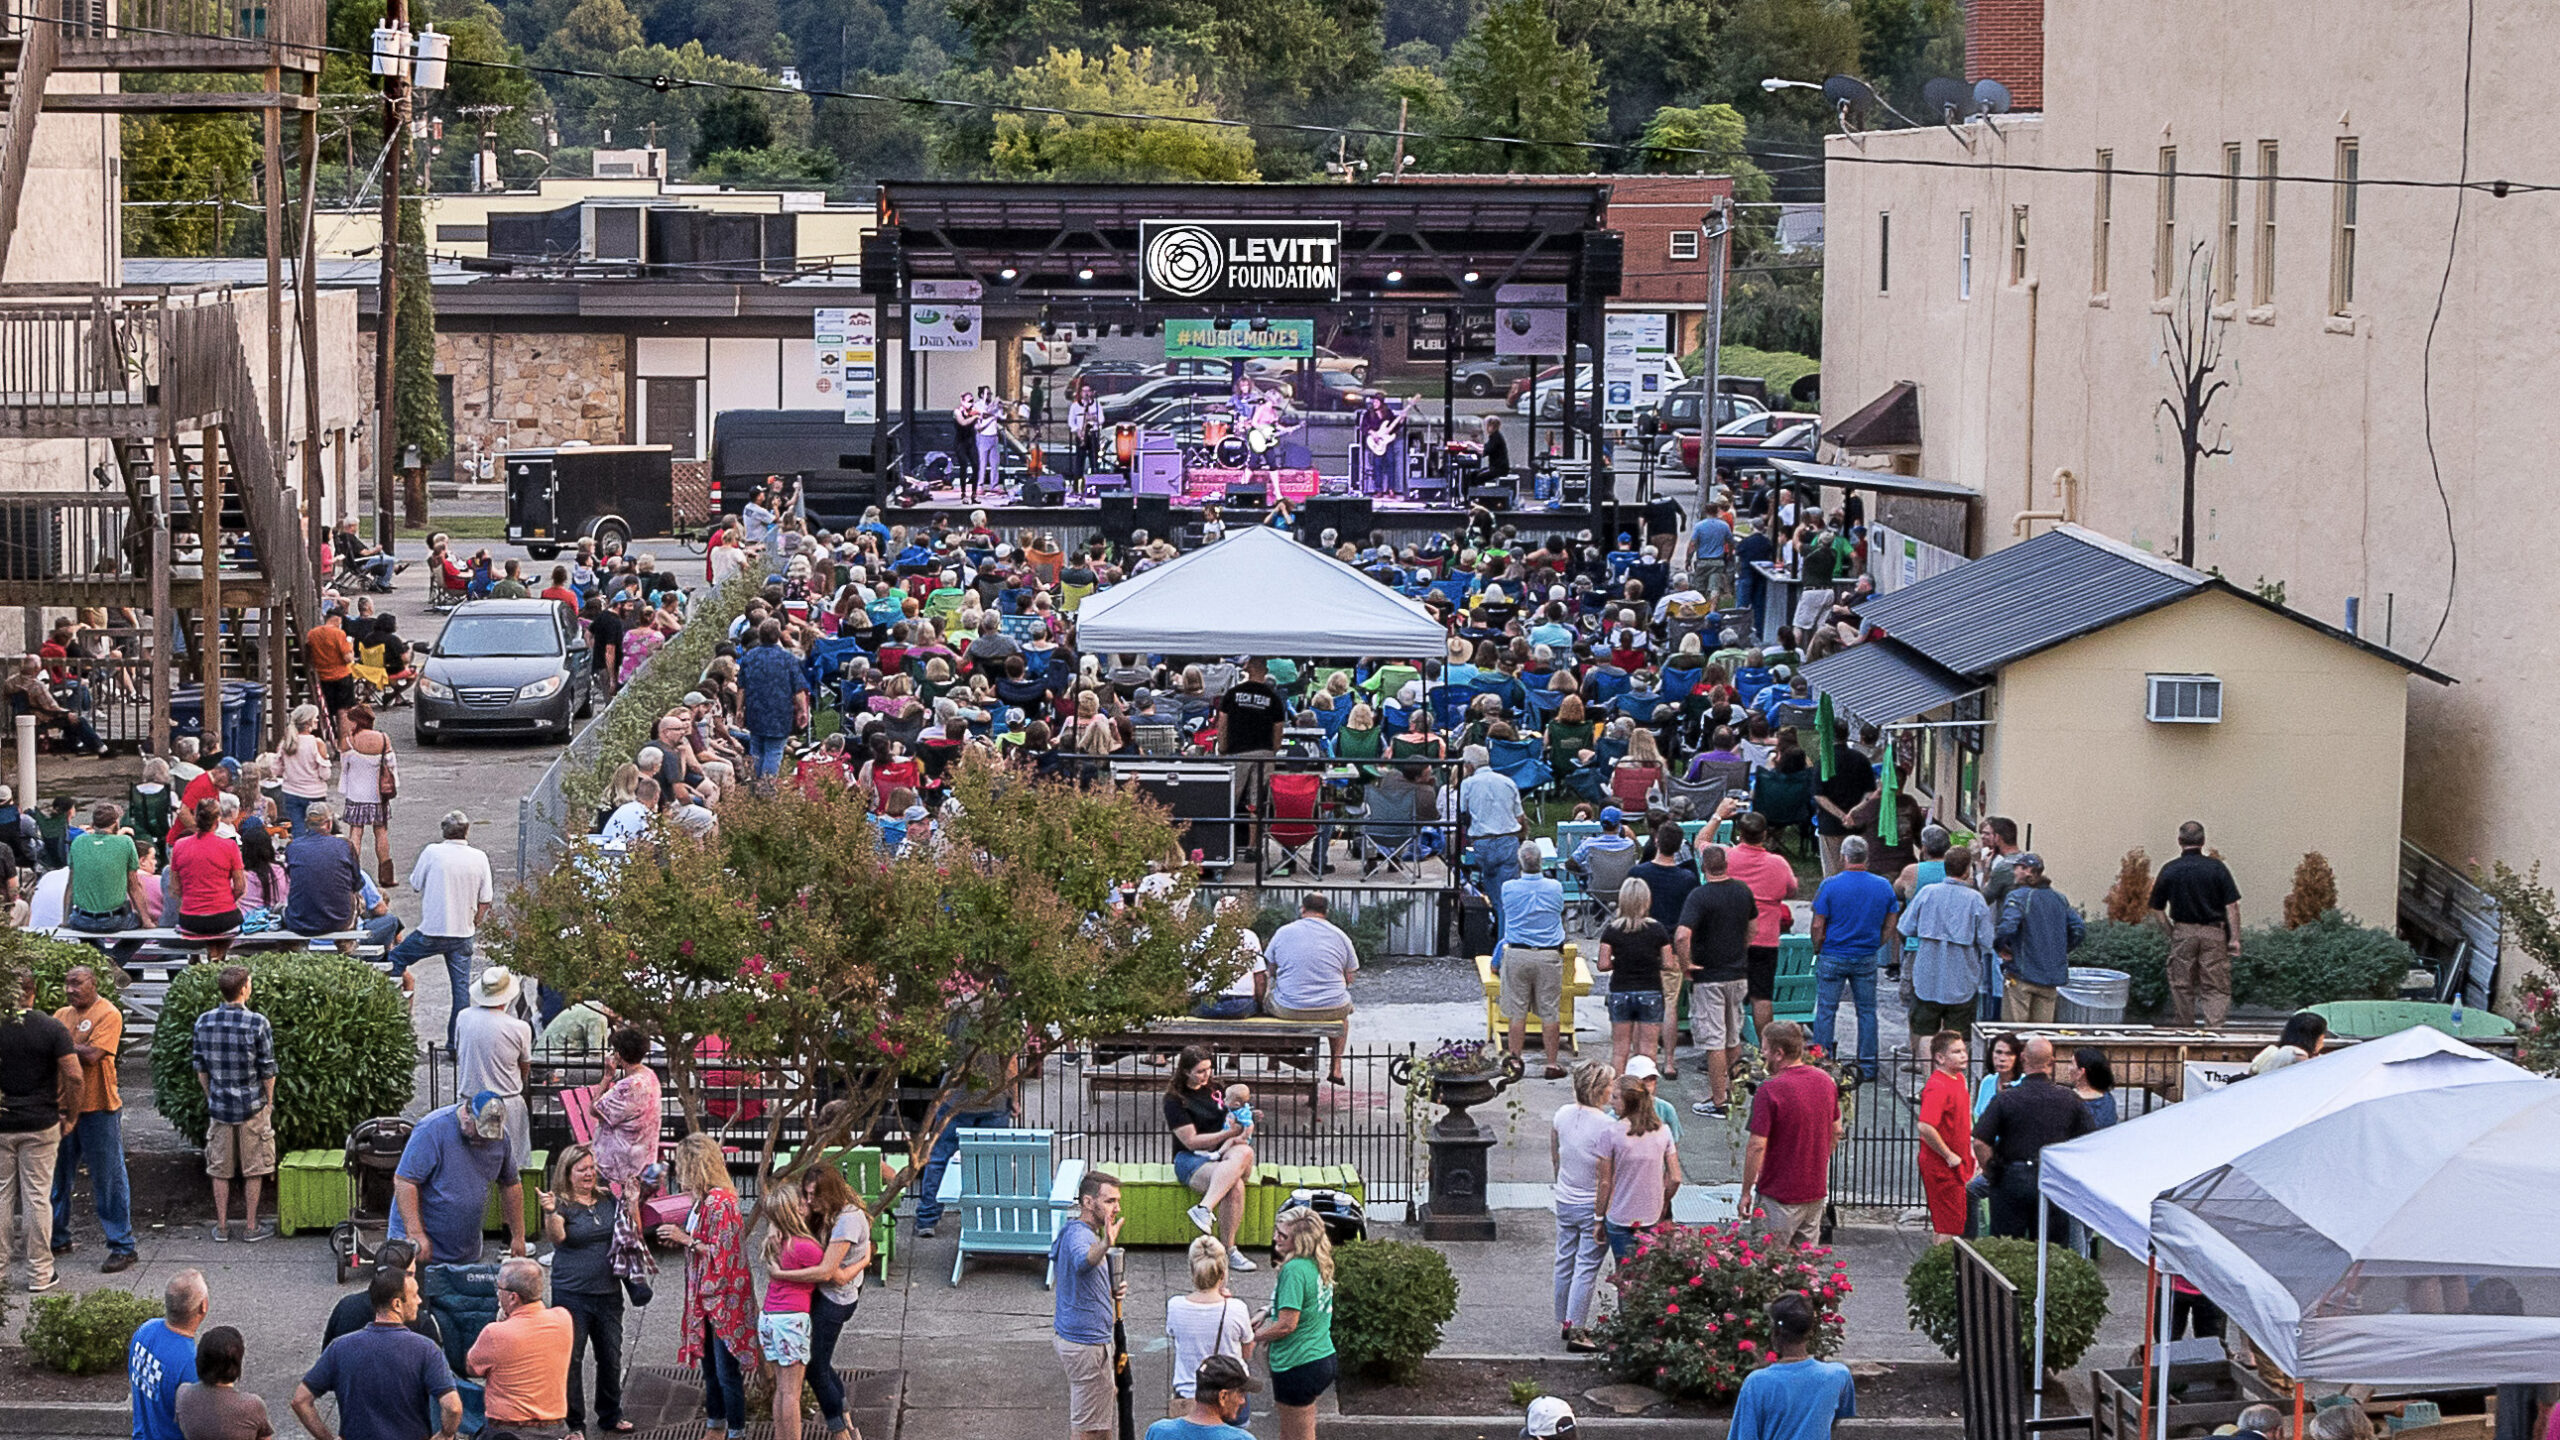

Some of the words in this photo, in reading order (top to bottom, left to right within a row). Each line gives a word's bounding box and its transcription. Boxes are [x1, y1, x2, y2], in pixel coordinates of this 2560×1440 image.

[1229, 237, 1337, 263] LEVITT
[1228, 265, 1336, 288] FOUNDATION
[1177, 328, 1299, 347] #MUSICMOVES
[1235, 692, 1251, 703] TECH
[1253, 693, 1271, 707] TEAM
[2204, 1070, 2231, 1083] Tha
